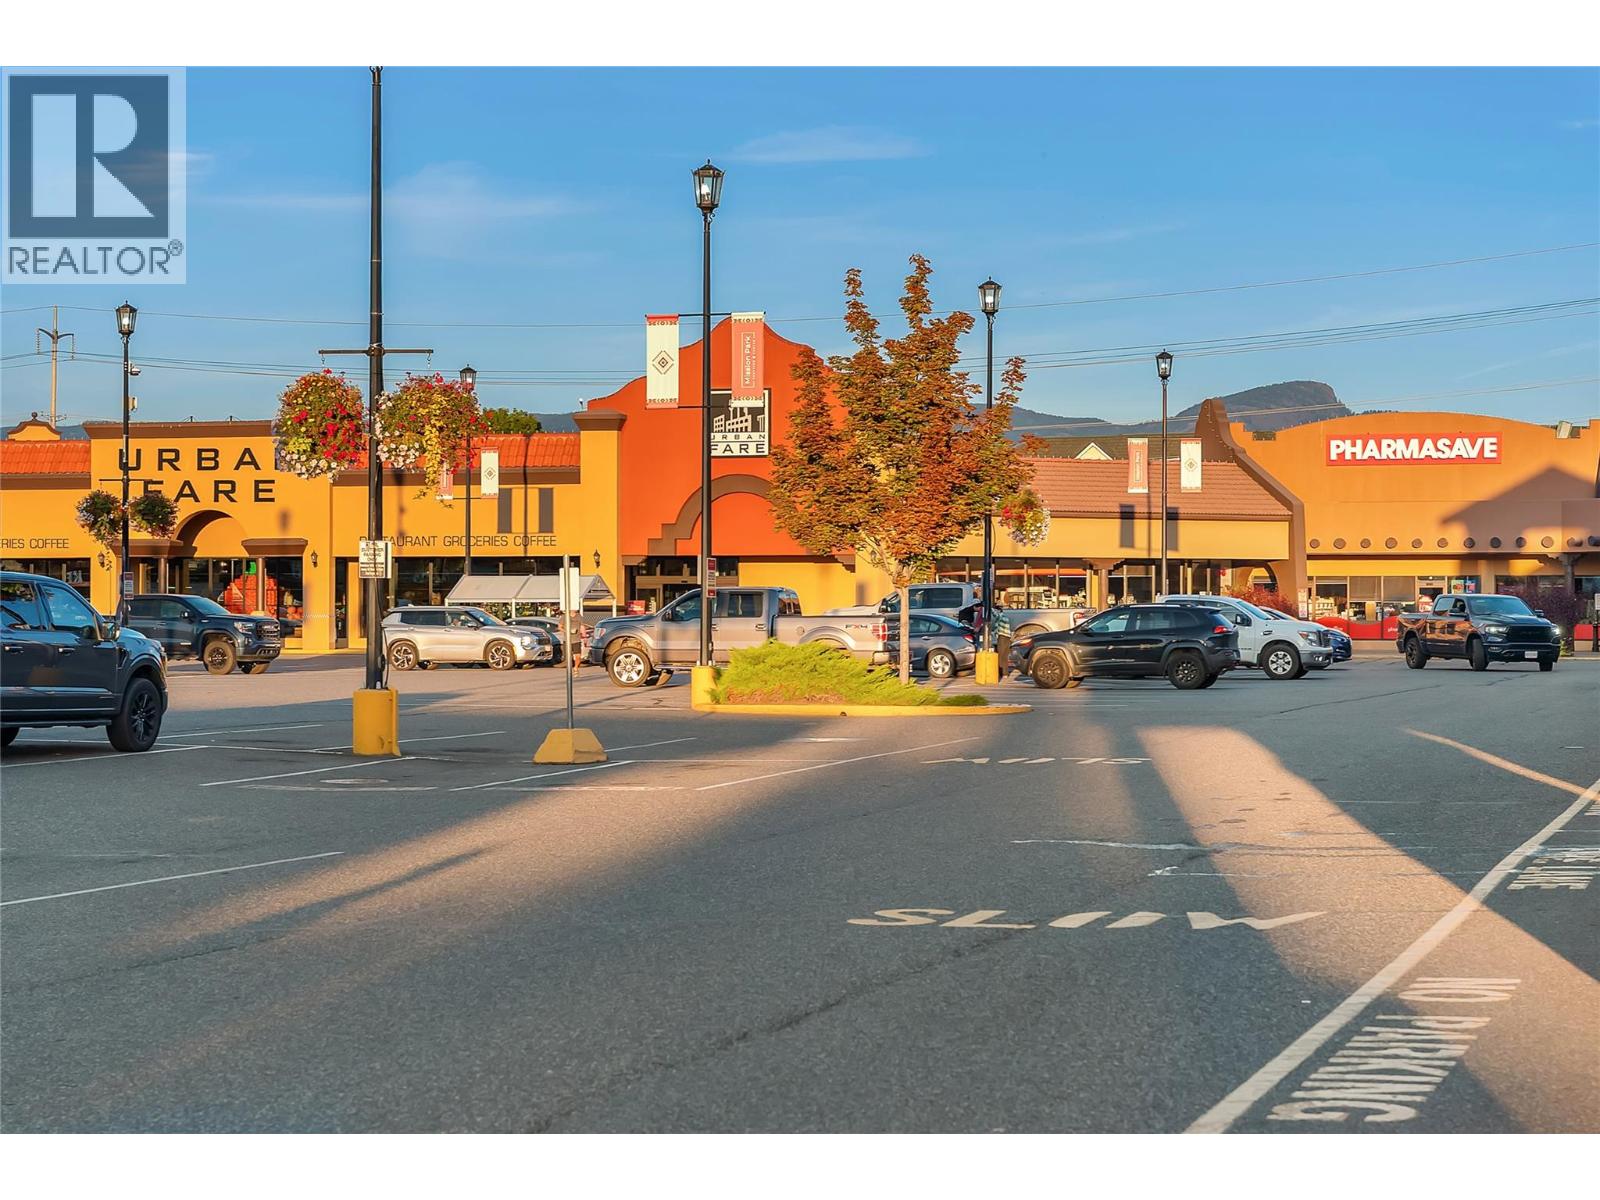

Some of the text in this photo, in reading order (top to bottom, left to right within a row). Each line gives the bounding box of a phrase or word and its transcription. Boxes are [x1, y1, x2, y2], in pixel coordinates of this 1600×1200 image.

[711, 443, 766, 454] FARE
[1329, 437, 1498, 461] PHARMASAVE
[143, 479, 276, 503] FARE
[0, 537, 70, 549] RIES COFFEE
[359, 536, 438, 547] TAURANT
[443, 535, 509, 547] GROCERIES
[513, 535, 557, 547] COFFEE
[847, 908, 1329, 930] SLOW
[1265, 976, 1522, 1122] NO PARKING
